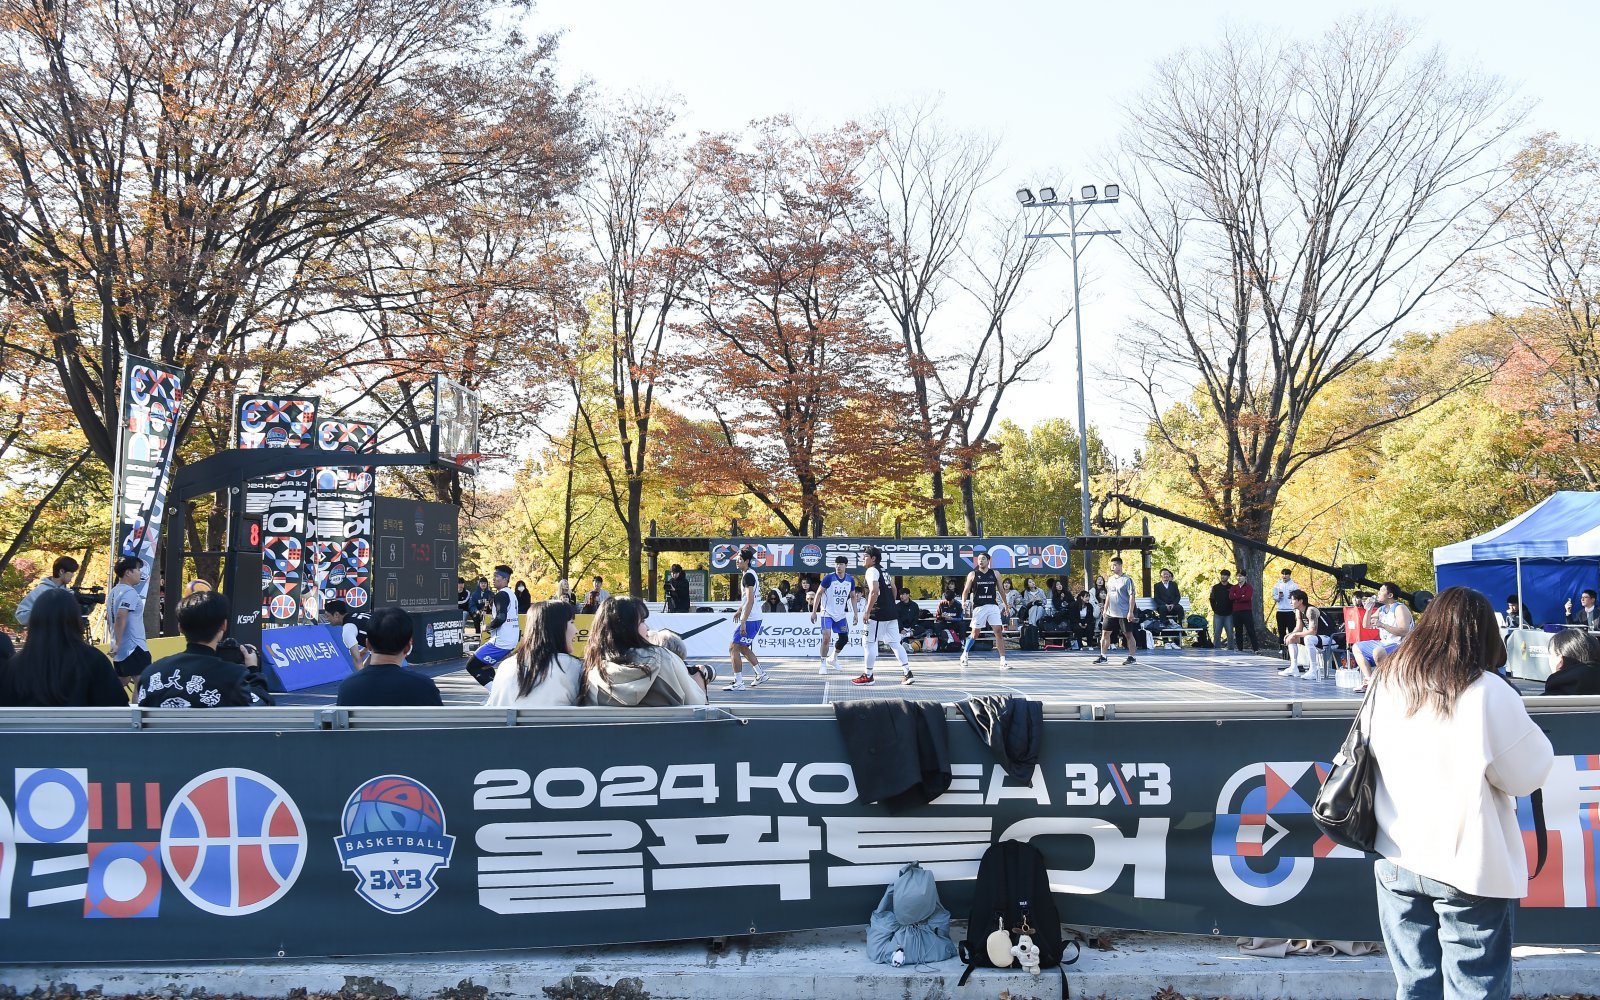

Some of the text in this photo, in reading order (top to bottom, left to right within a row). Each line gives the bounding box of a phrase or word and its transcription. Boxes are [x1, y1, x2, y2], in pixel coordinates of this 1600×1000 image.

[249, 523, 259, 545] 8
[389, 543, 396, 561] 8
[442, 545, 448, 562] 6
[389, 582, 395, 597] 0
[983, 586, 989, 594] 7
[835, 597, 845, 605] 99
[236, 614, 255, 624] KSPO
[757, 625, 823, 636] KSPO&C
[285, 641, 339, 664] 아이에스동서
[473, 763, 720, 811] 2024
[736, 761, 1052, 806] KOEA
[1065, 762, 1171, 806] 3X3
[345, 836, 444, 852] BASKETBALL
[474, 814, 1171, 915] 올팍투어
[369, 869, 422, 890] 3X3
